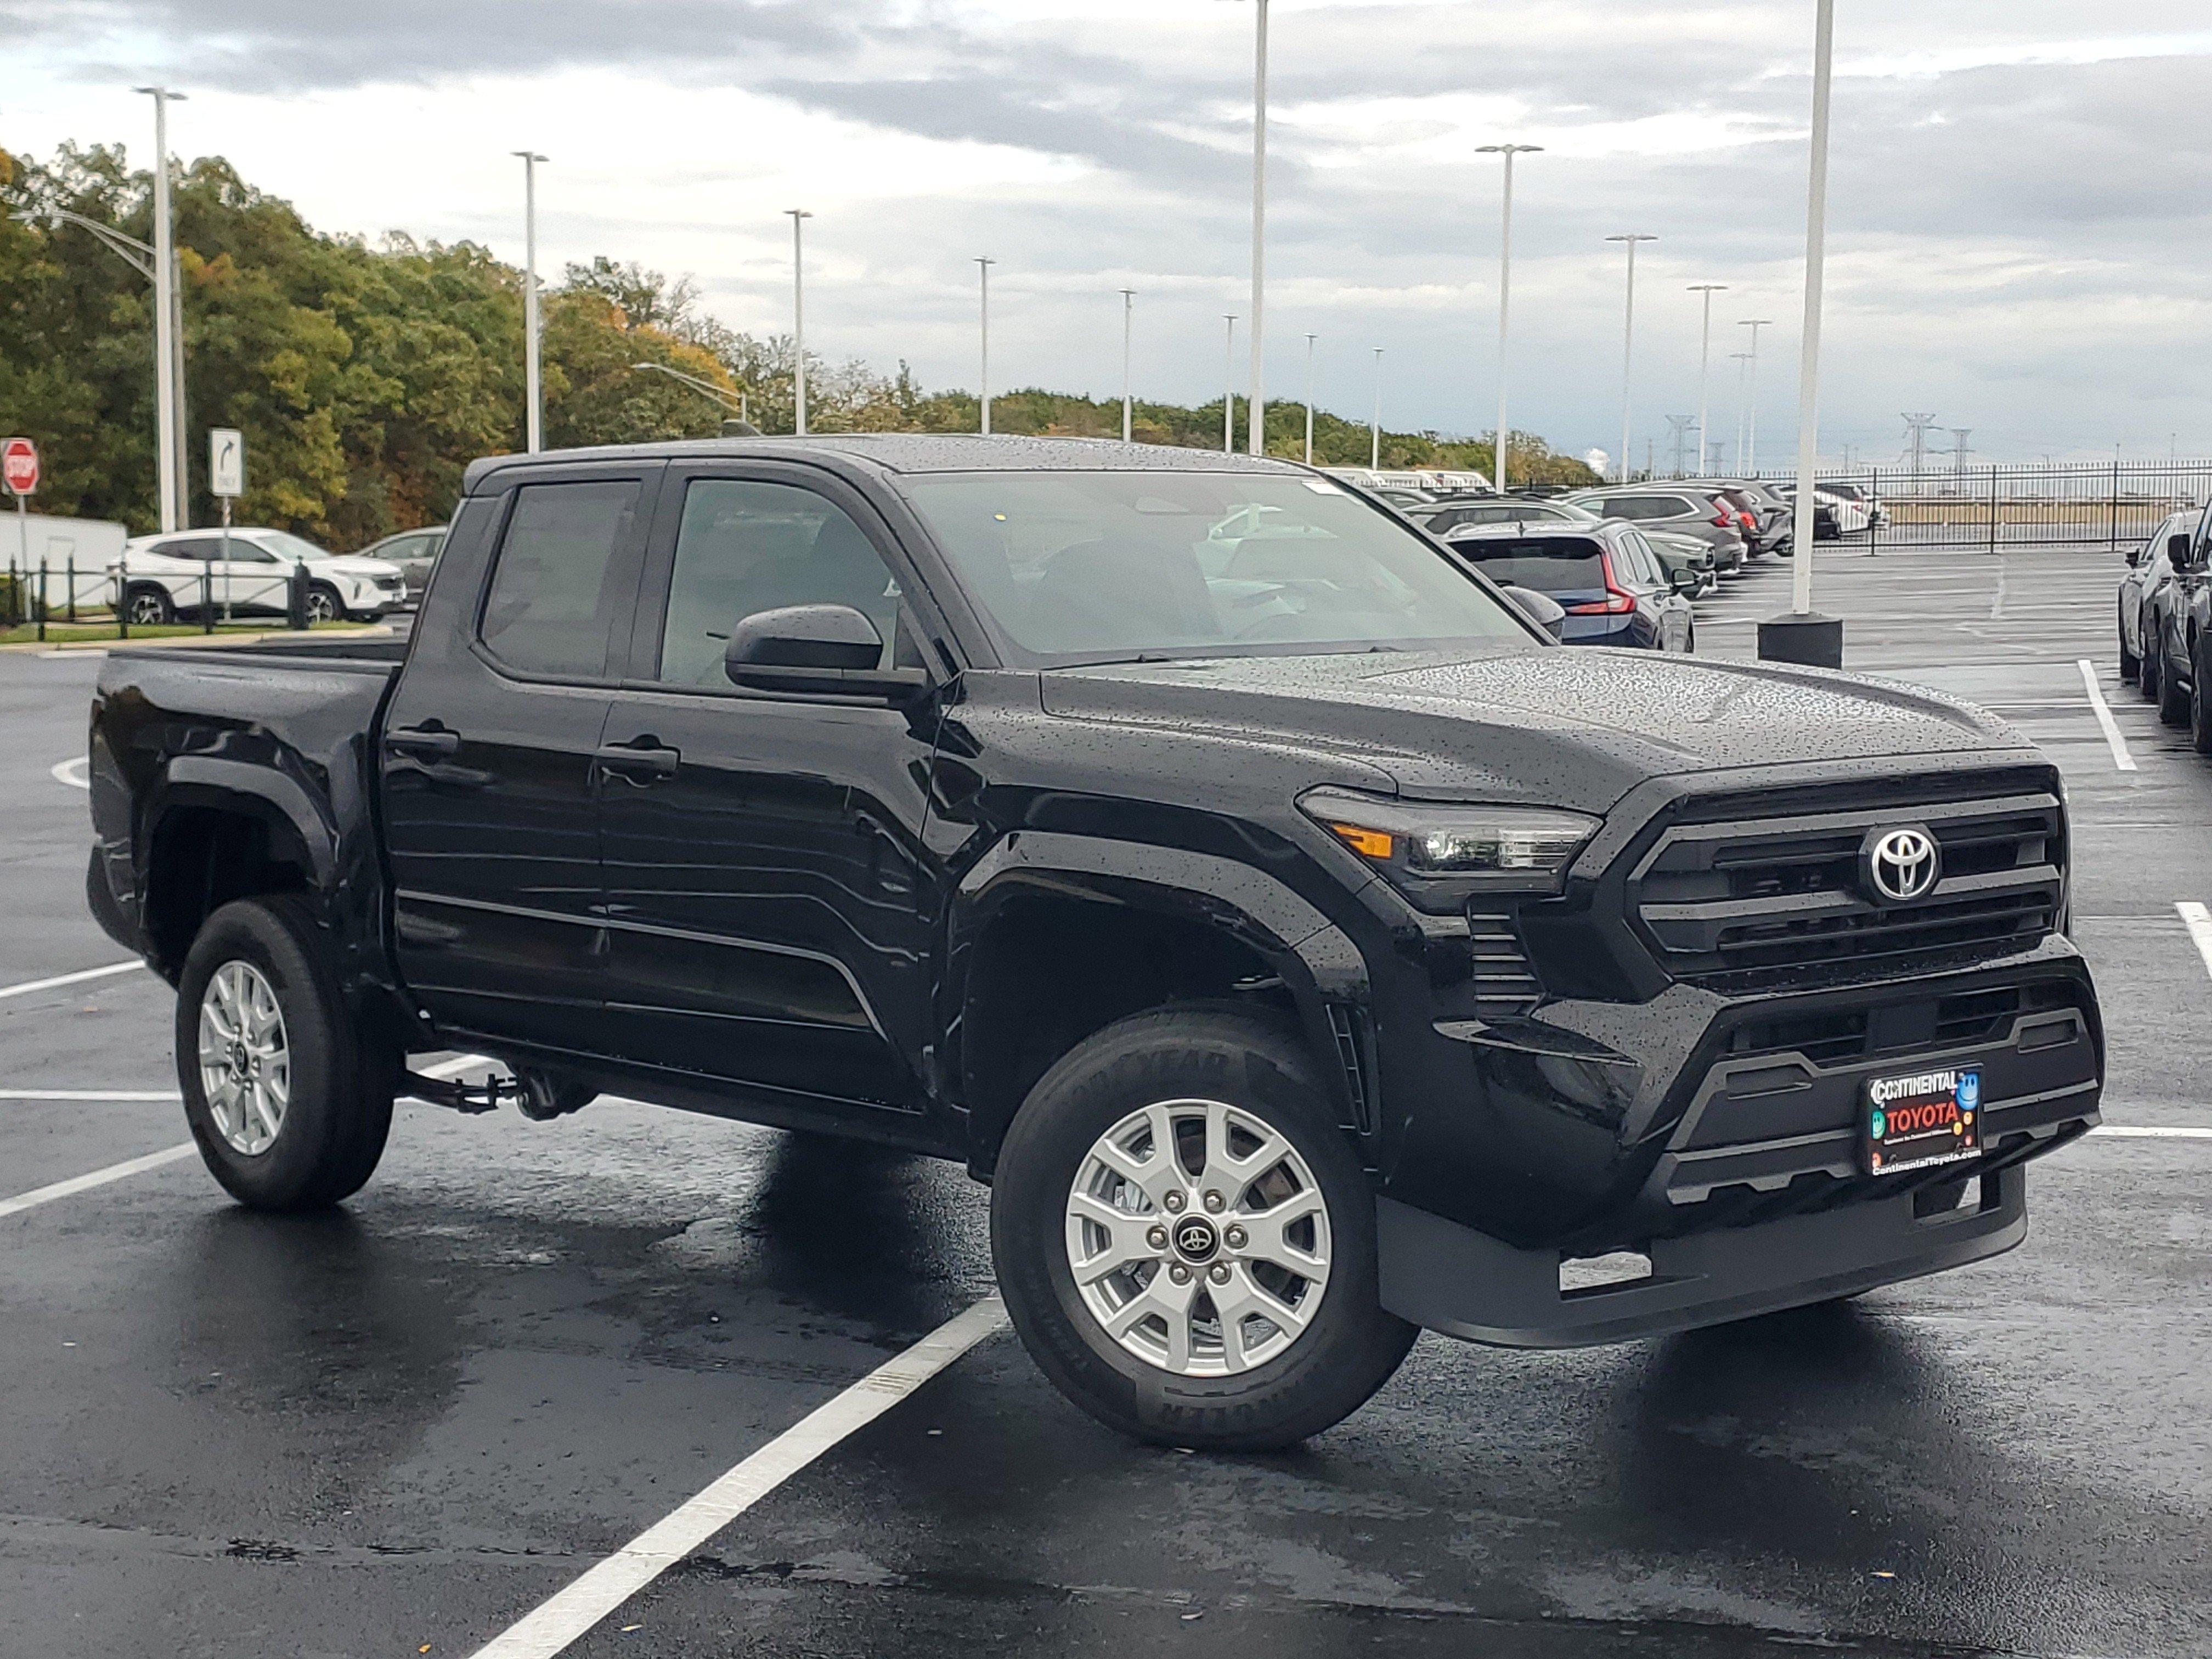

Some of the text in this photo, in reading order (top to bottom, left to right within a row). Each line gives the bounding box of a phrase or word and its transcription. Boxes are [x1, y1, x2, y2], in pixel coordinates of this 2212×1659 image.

[1871, 1071, 1958, 1104] CONTINENTAL
[1887, 1101, 1959, 1133] TOYOTA
[1872, 1150, 1982, 1176] ContinentalToyota.com
